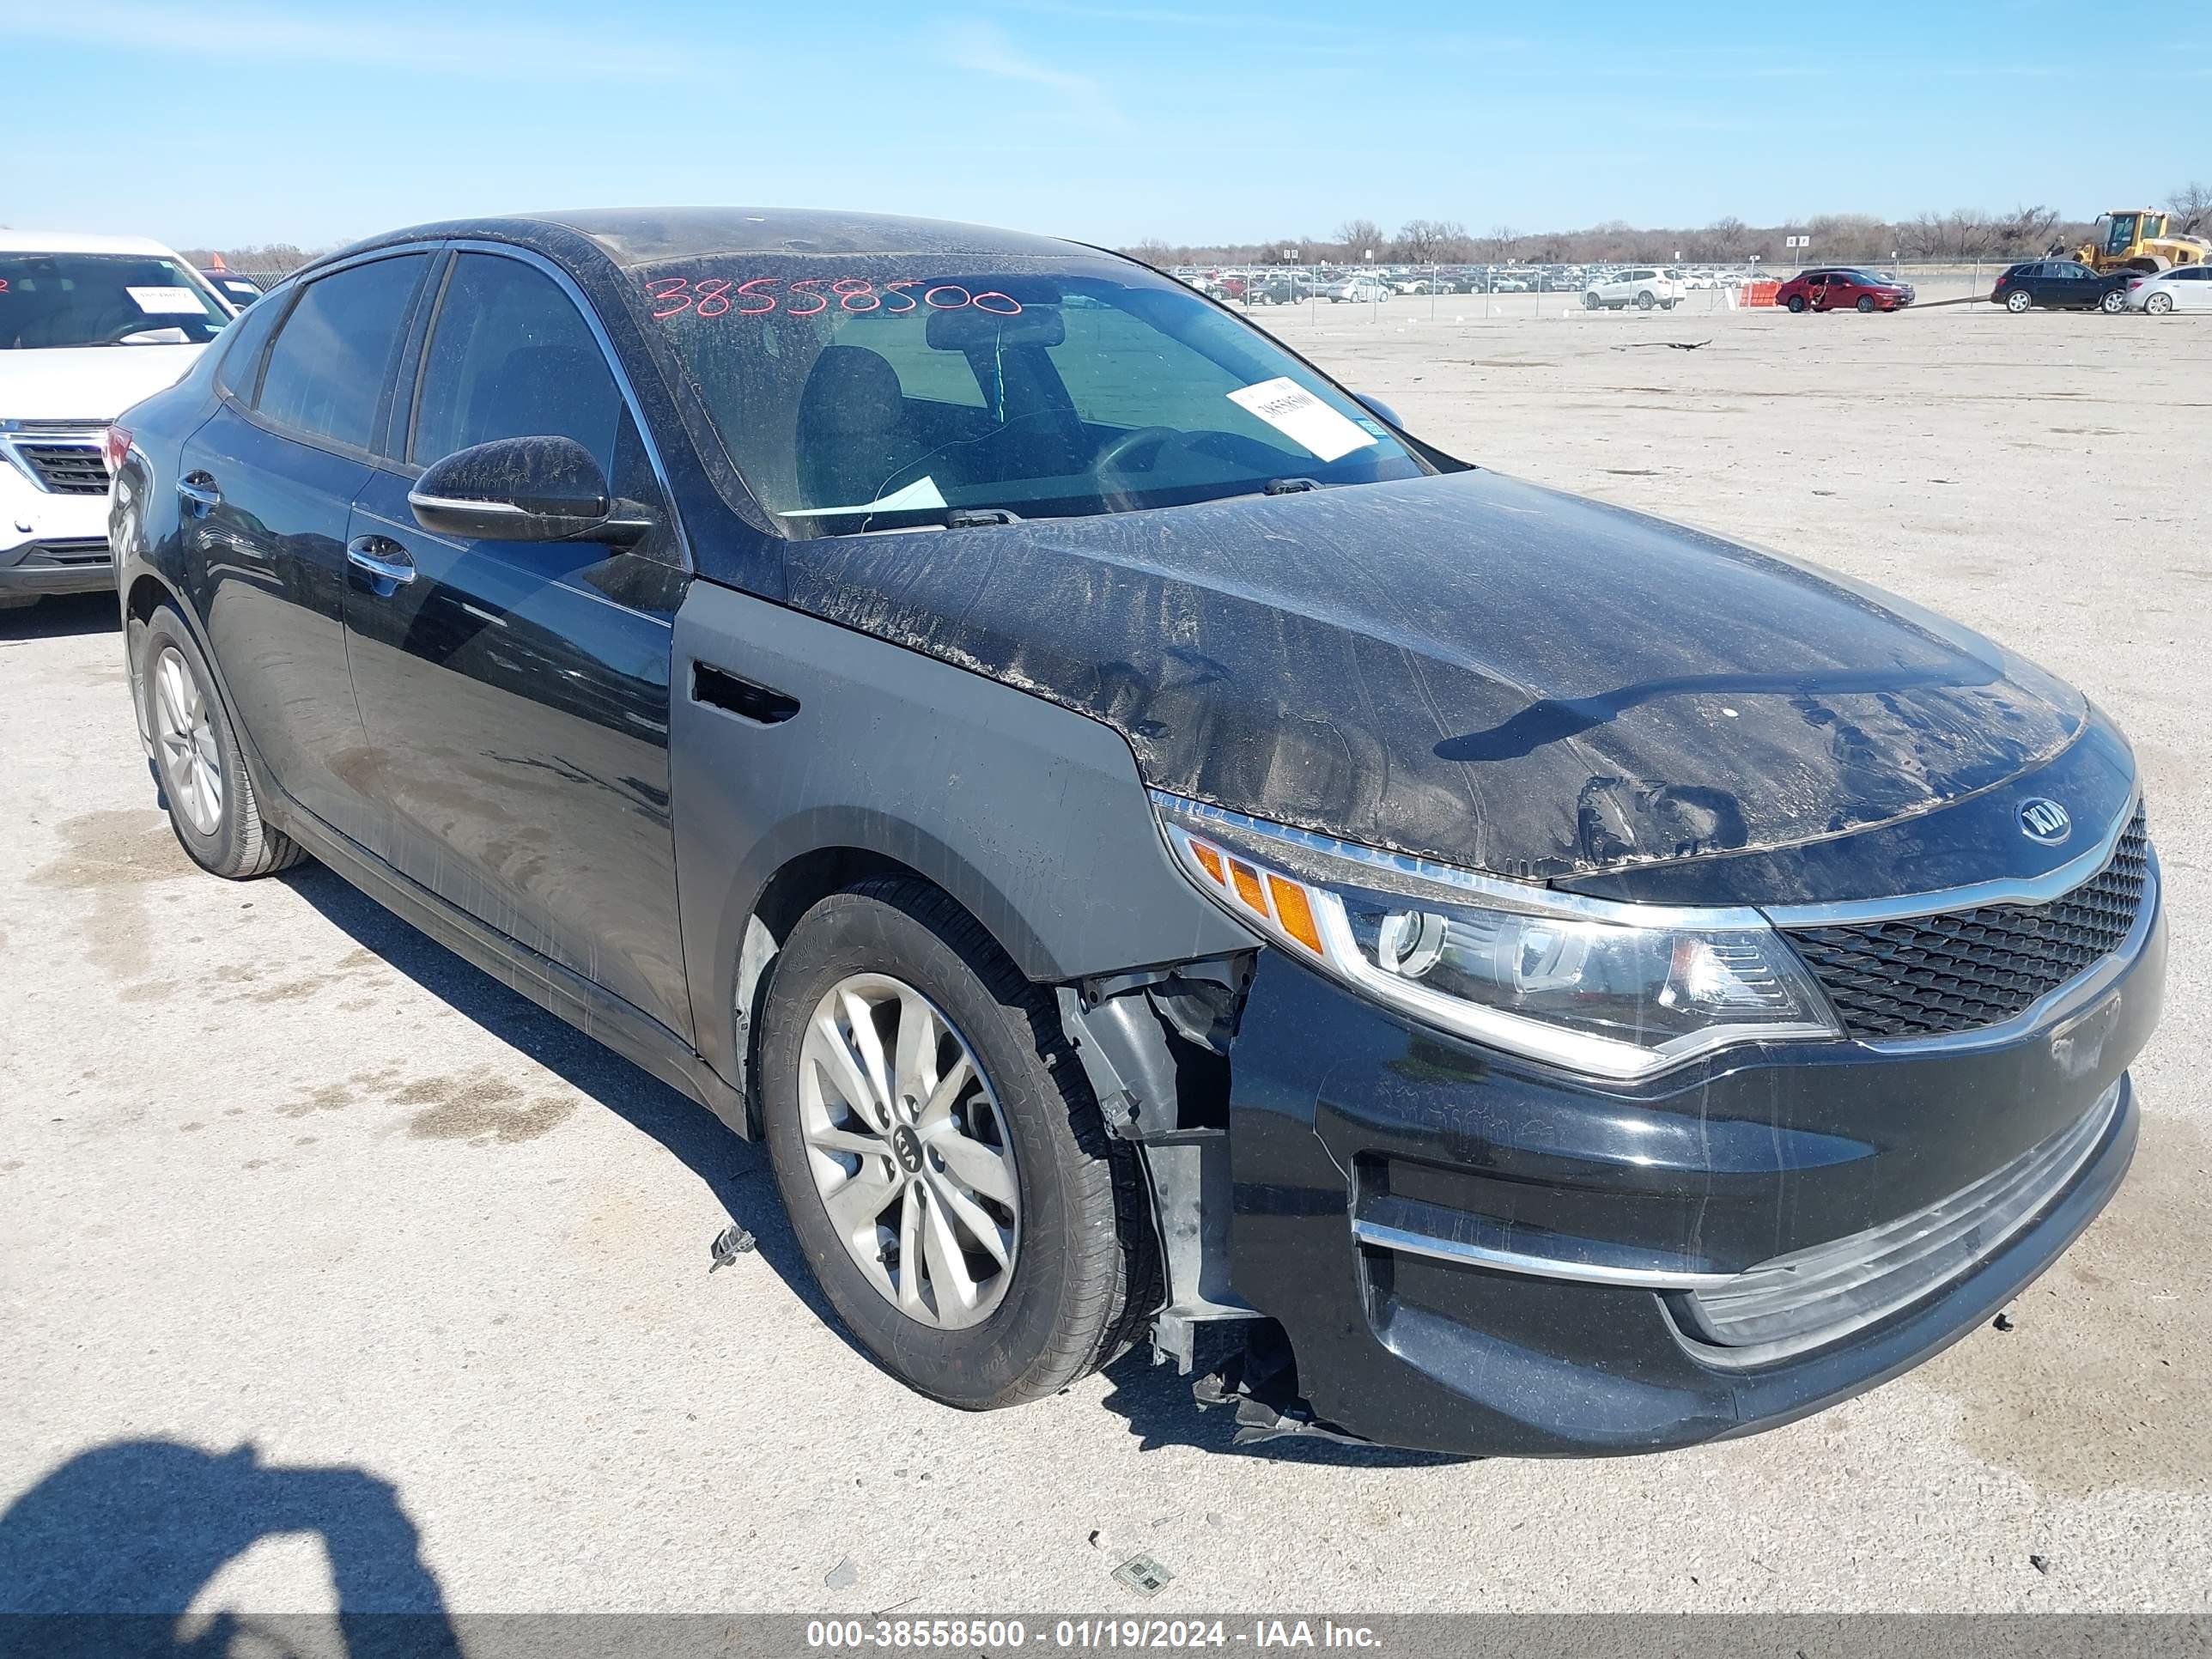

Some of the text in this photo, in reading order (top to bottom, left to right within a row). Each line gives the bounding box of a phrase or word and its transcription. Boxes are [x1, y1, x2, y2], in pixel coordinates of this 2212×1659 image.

[646, 277, 1023, 317] 38558500
[2021, 801, 2069, 836] KIA
[895, 1130, 916, 1170] KIA
